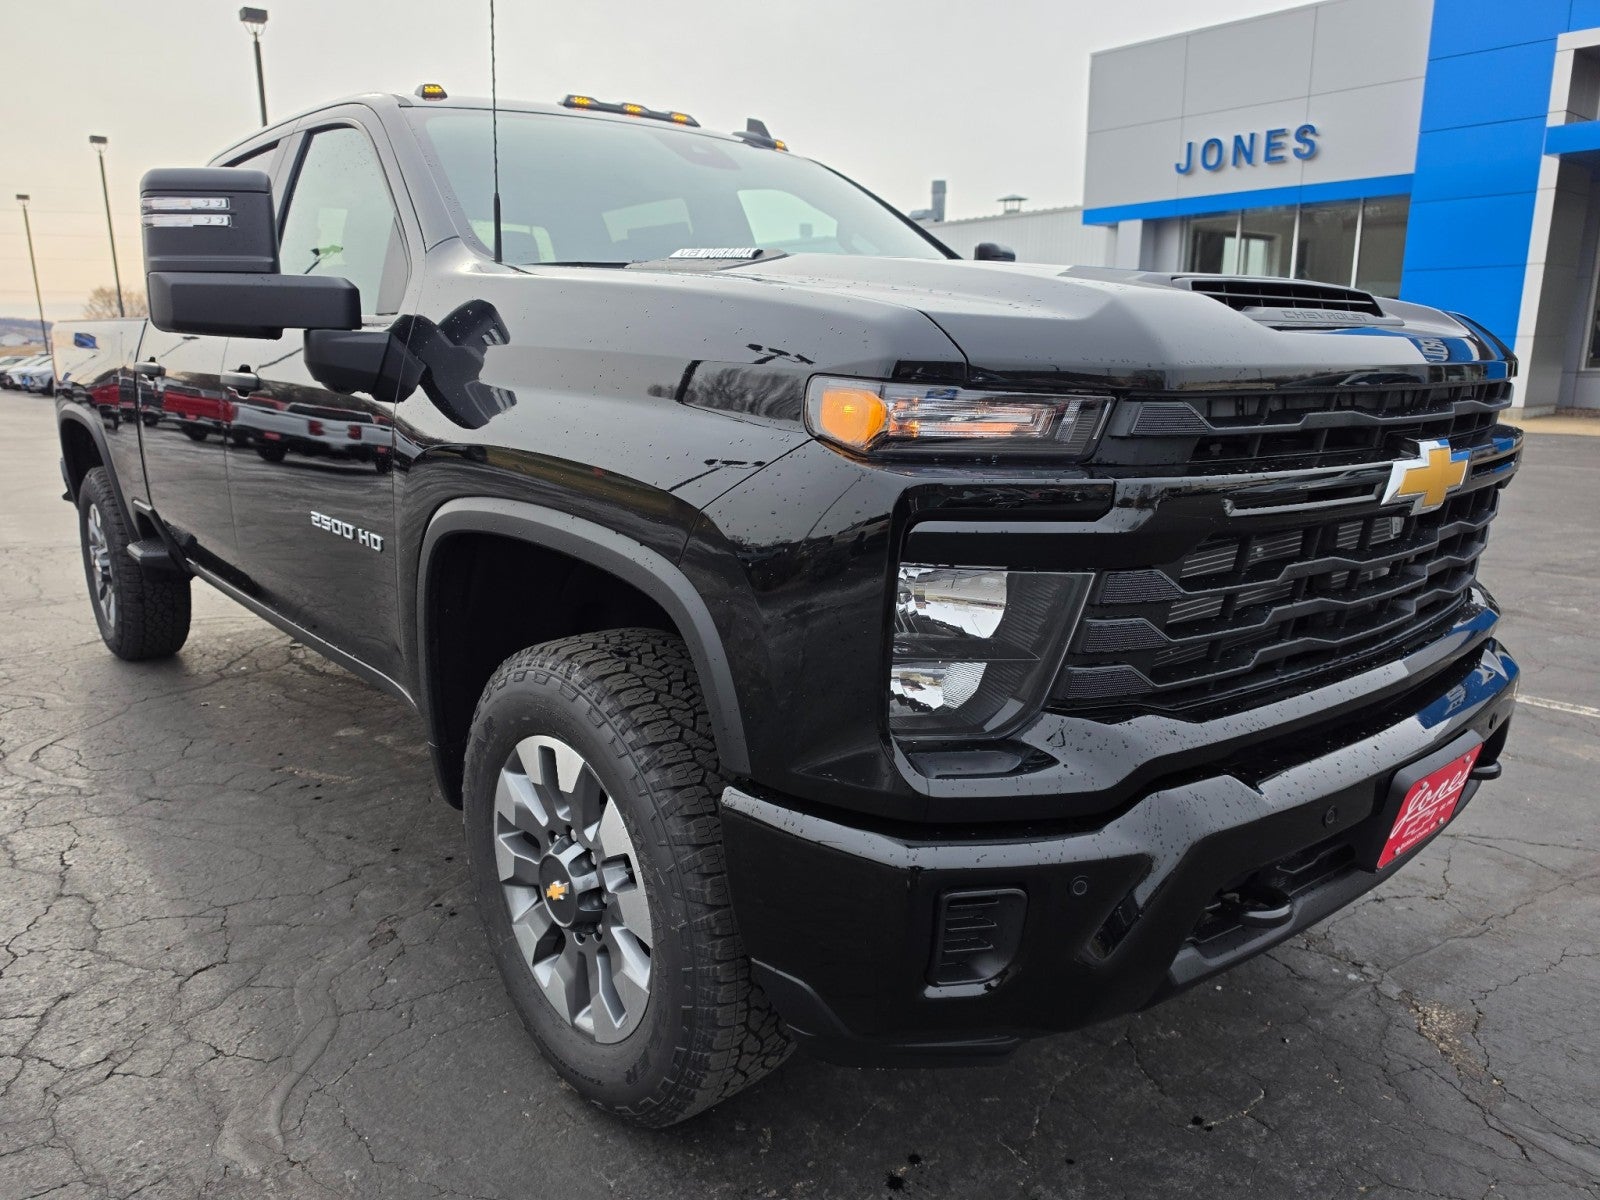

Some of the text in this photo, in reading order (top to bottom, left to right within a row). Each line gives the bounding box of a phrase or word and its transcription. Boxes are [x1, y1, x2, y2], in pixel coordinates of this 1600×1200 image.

[1175, 124, 1319, 175] JONES
[701, 247, 757, 259] DURAMAX
[1281, 310, 1368, 323] CHEVROLET
[310, 510, 384, 552] 2500 HD
[1389, 761, 1474, 839] Jones
